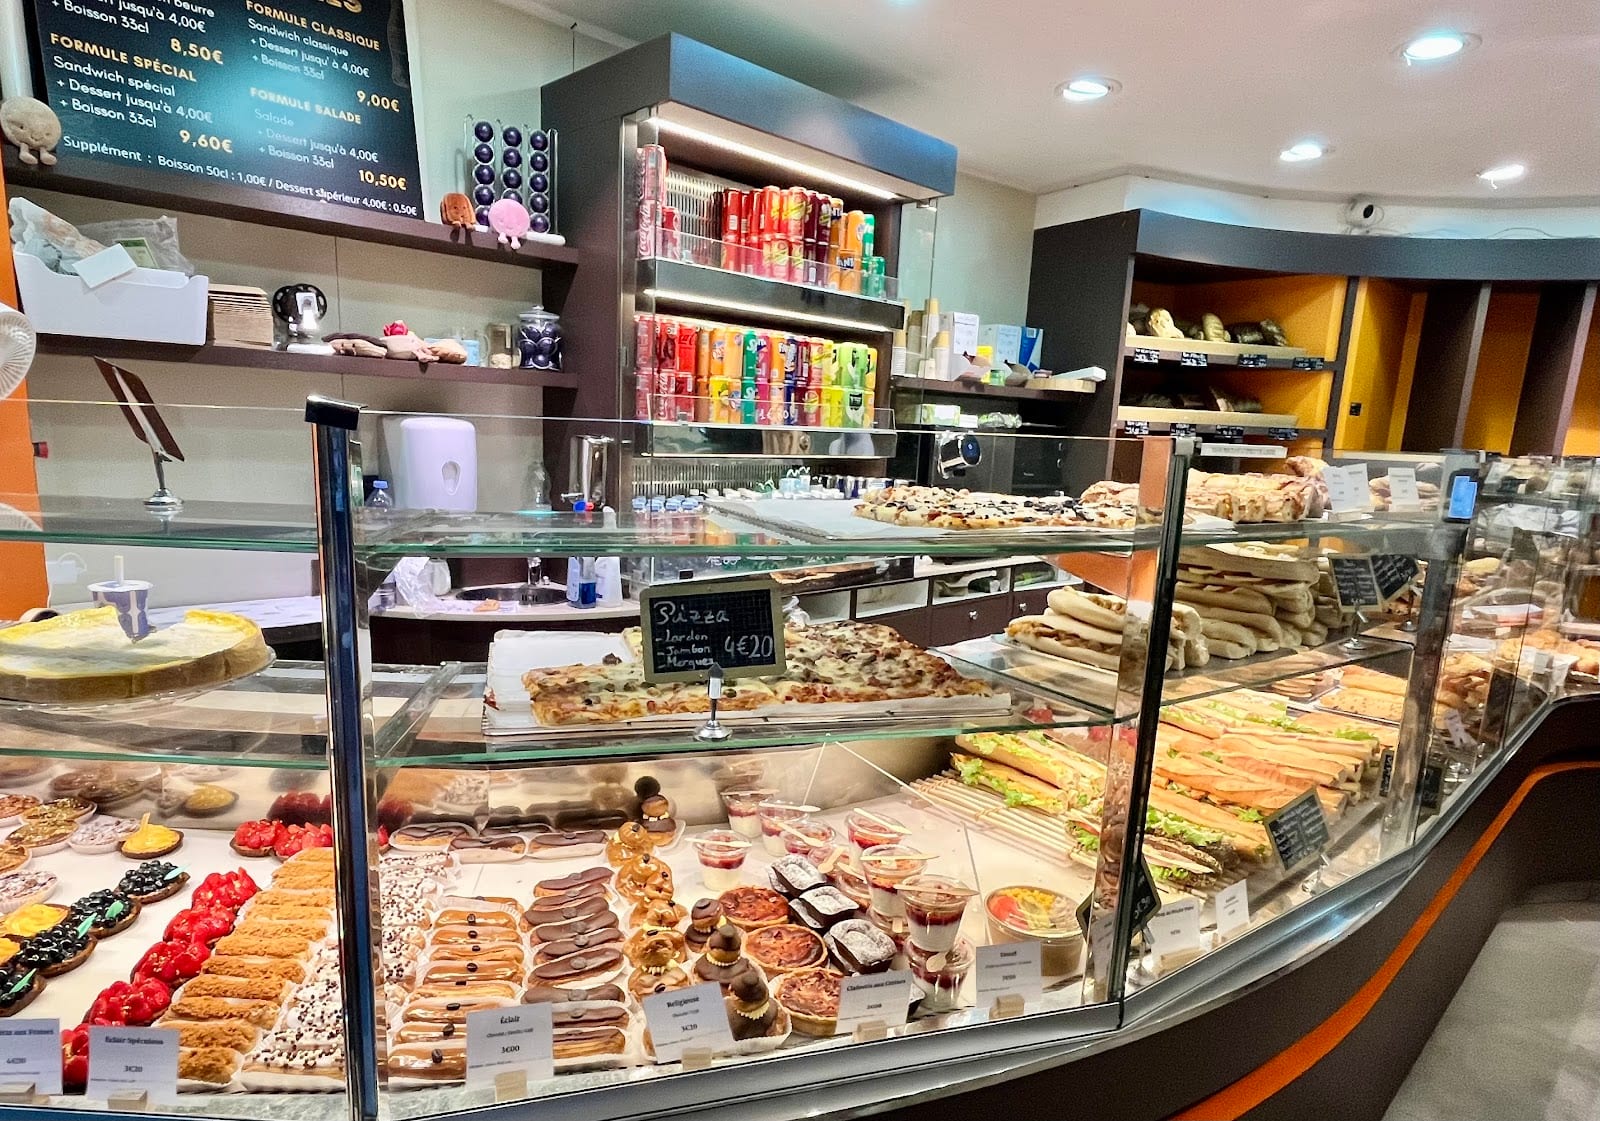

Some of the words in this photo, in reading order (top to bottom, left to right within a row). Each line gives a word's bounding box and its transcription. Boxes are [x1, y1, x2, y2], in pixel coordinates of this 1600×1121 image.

[64, 1, 117, 25] Boisson
[120, 15, 149, 33] 33cl
[118, 0, 166, 21] jusqu'à
[169, 13, 207, 33] 4,00€
[173, 0, 216, 17] beurre
[246, 0, 308, 29] FORMULE
[311, 21, 381, 51] CLASSIQUE
[248, 18, 300, 42] Sandwich
[303, 36, 349, 57] classique
[50, 32, 129, 64] FORMULE
[133, 55, 197, 82] SPÉCIAL
[170, 38, 224, 65] 8,50€
[259, 37, 299, 57] Dessert
[342, 62, 370, 79] 4,00€
[260, 53, 300, 73] Boisson
[303, 65, 325, 80] 33cl
[54, 55, 125, 84] Sandwich
[128, 76, 176, 97] spécial
[69, 79, 122, 101] Dessert
[125, 94, 172, 114] jusqu'à
[176, 105, 213, 124] 4,00€
[72, 98, 125, 121] Boisson
[129, 111, 157, 128] 33cl
[250, 87, 311, 112] FORMULE
[315, 104, 361, 124] SALADE
[356, 90, 400, 112] 9,00€
[255, 108, 295, 127] Salade
[179, 129, 233, 153] 9,60€
[266, 128, 307, 147] Dessert
[310, 137, 347, 155] jusqu'à
[349, 148, 379, 163] 4,00€
[268, 145, 310, 163] Boisson
[312, 154, 335, 169] 33cl
[63, 135, 142, 162] Supplément
[158, 155, 204, 174] Boisson
[206, 165, 229, 179] 50cl
[237, 172, 267, 187] 1,00€
[275, 179, 313, 197] Dessert
[362, 197, 387, 210] 4,00€
[393, 203, 417, 216] 0,50€
[358, 169, 407, 191] 10,50€
[654, 601, 730, 625] Pizza
[666, 629, 708, 643] Lardon
[724, 634, 774, 659] 4€20
